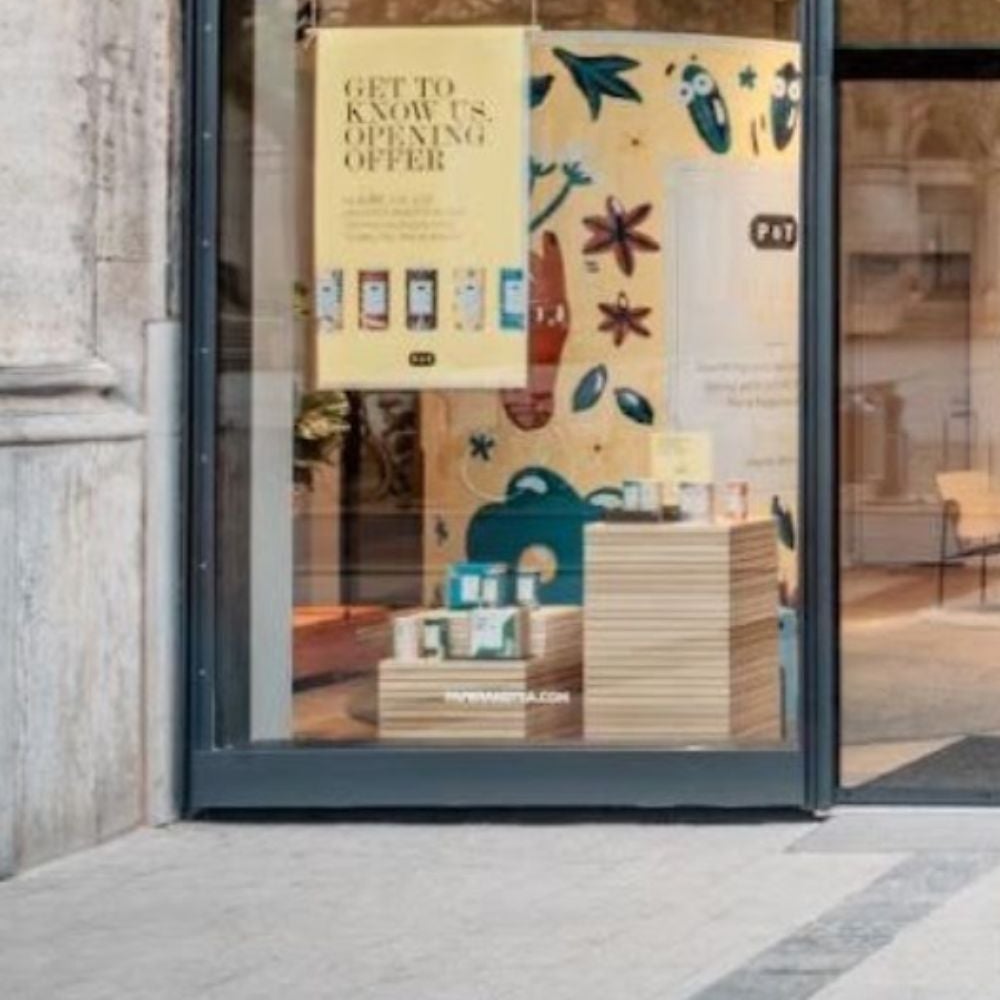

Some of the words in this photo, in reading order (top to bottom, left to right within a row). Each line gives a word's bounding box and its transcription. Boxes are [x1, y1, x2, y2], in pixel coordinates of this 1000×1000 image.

[344, 76, 406, 99] GET
[413, 76, 455, 99] TO
[346, 101, 436, 122] KNOW
[344, 125, 486, 146] OPENING
[344, 149, 446, 171] OFFER
